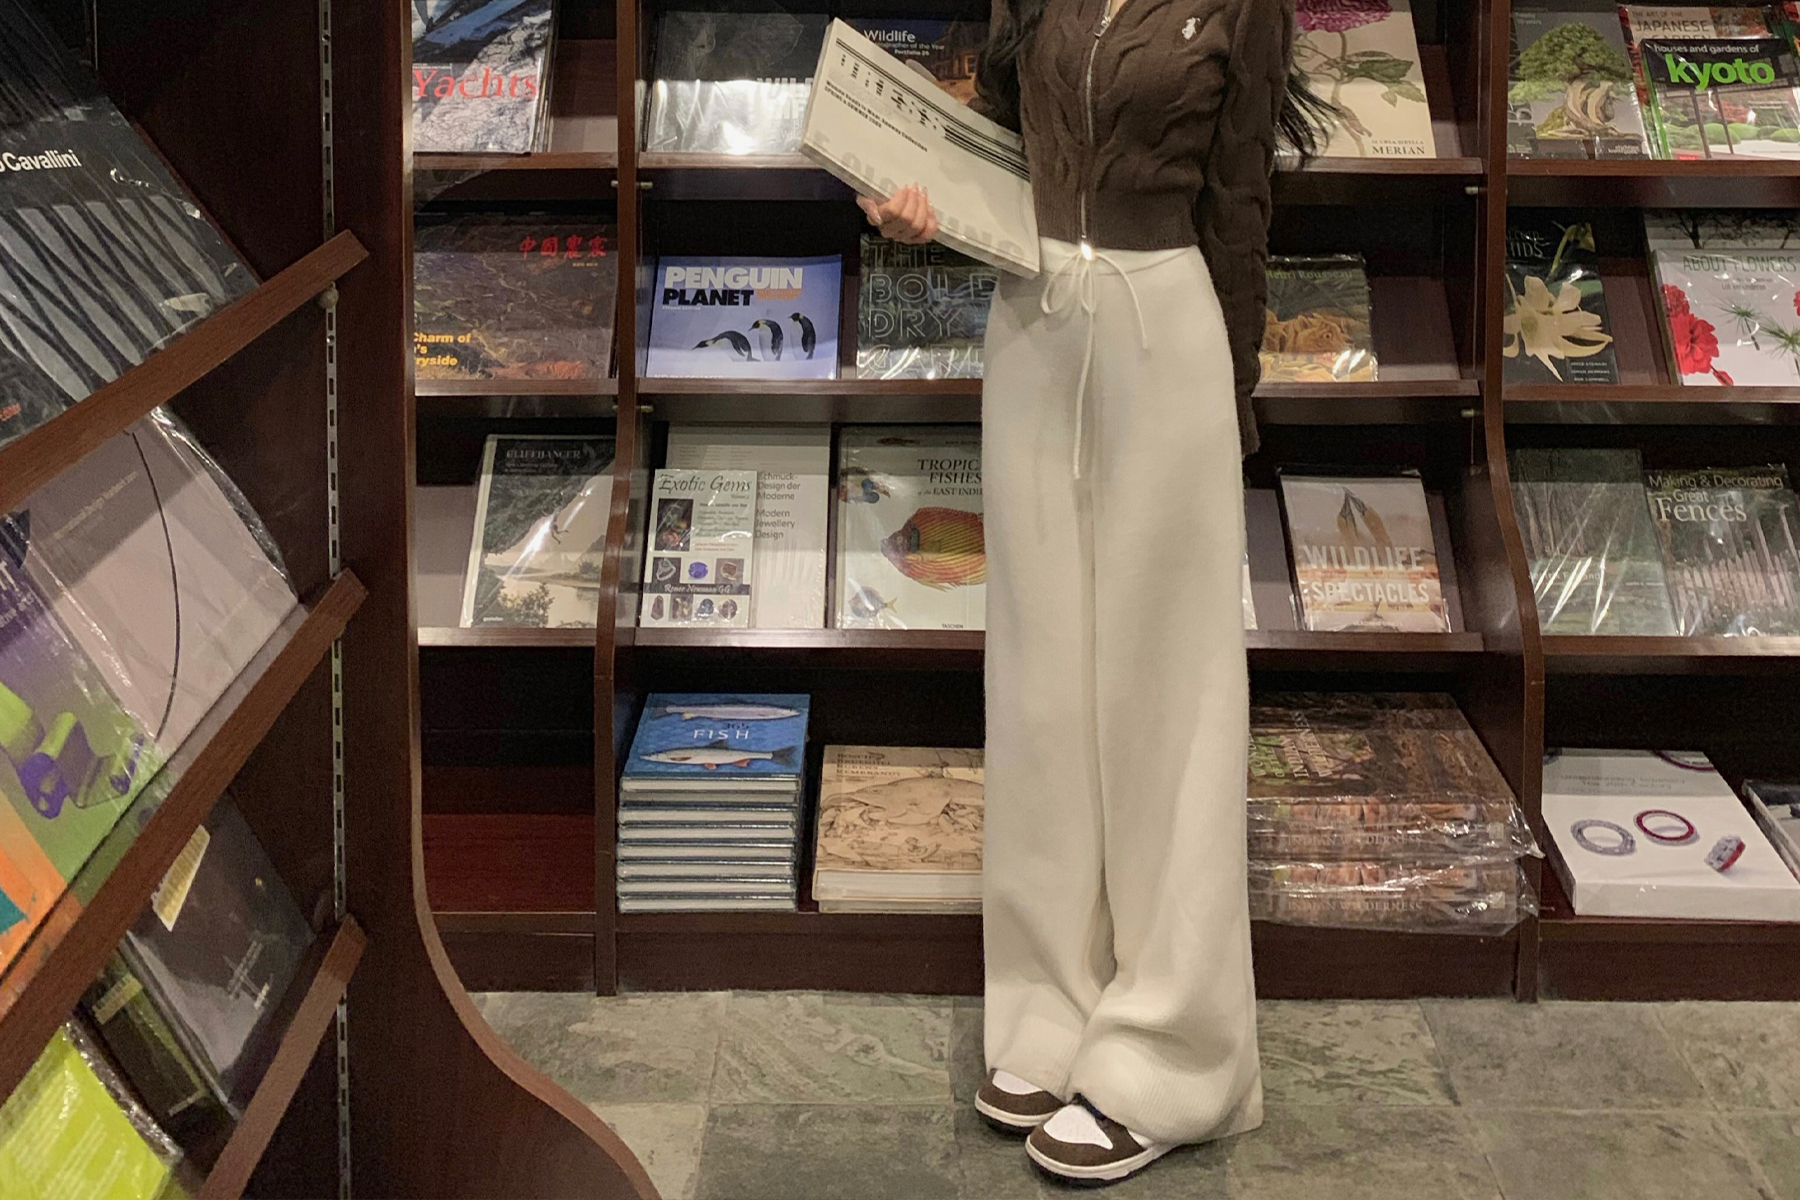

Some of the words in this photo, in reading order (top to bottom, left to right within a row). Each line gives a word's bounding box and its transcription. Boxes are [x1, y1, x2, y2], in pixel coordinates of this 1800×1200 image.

[1636, 19, 1709, 32] JAPANESE
[864, 30, 916, 43] Wildlife
[1654, 44, 1687, 52] houses
[1709, 45, 1747, 54] gardens
[1749, 44, 1759, 52] of
[1665, 53, 1775, 91] kyoto
[413, 67, 539, 98] Yachts
[1372, 145, 1425, 155] MERIAN
[2, 149, 82, 171] Cavallini
[1683, 256, 1727, 271] ABOUT
[1731, 256, 1797, 272] FLOWERS
[664, 266, 803, 289] PENGUIN
[662, 289, 754, 306] PLANET
[869, 308, 962, 337] DRY
[457, 332, 473, 344] of
[917, 459, 981, 471] TROPIC
[659, 474, 705, 494] Exotic
[710, 475, 751, 492] Gems
[787, 482, 800, 490] der
[930, 472, 982, 484] FISHES
[1649, 475, 1697, 490] Making
[1700, 475, 1710, 487] &
[1714, 474, 1784, 490] Decorating
[933, 487, 956, 496] EAST
[1673, 489, 1710, 503] Great
[1656, 497, 1747, 523] Fences
[1303, 544, 1424, 571] WILDLIFE
[1311, 581, 1430, 604] SPECTACLES
[694, 728, 750, 740] FISH
